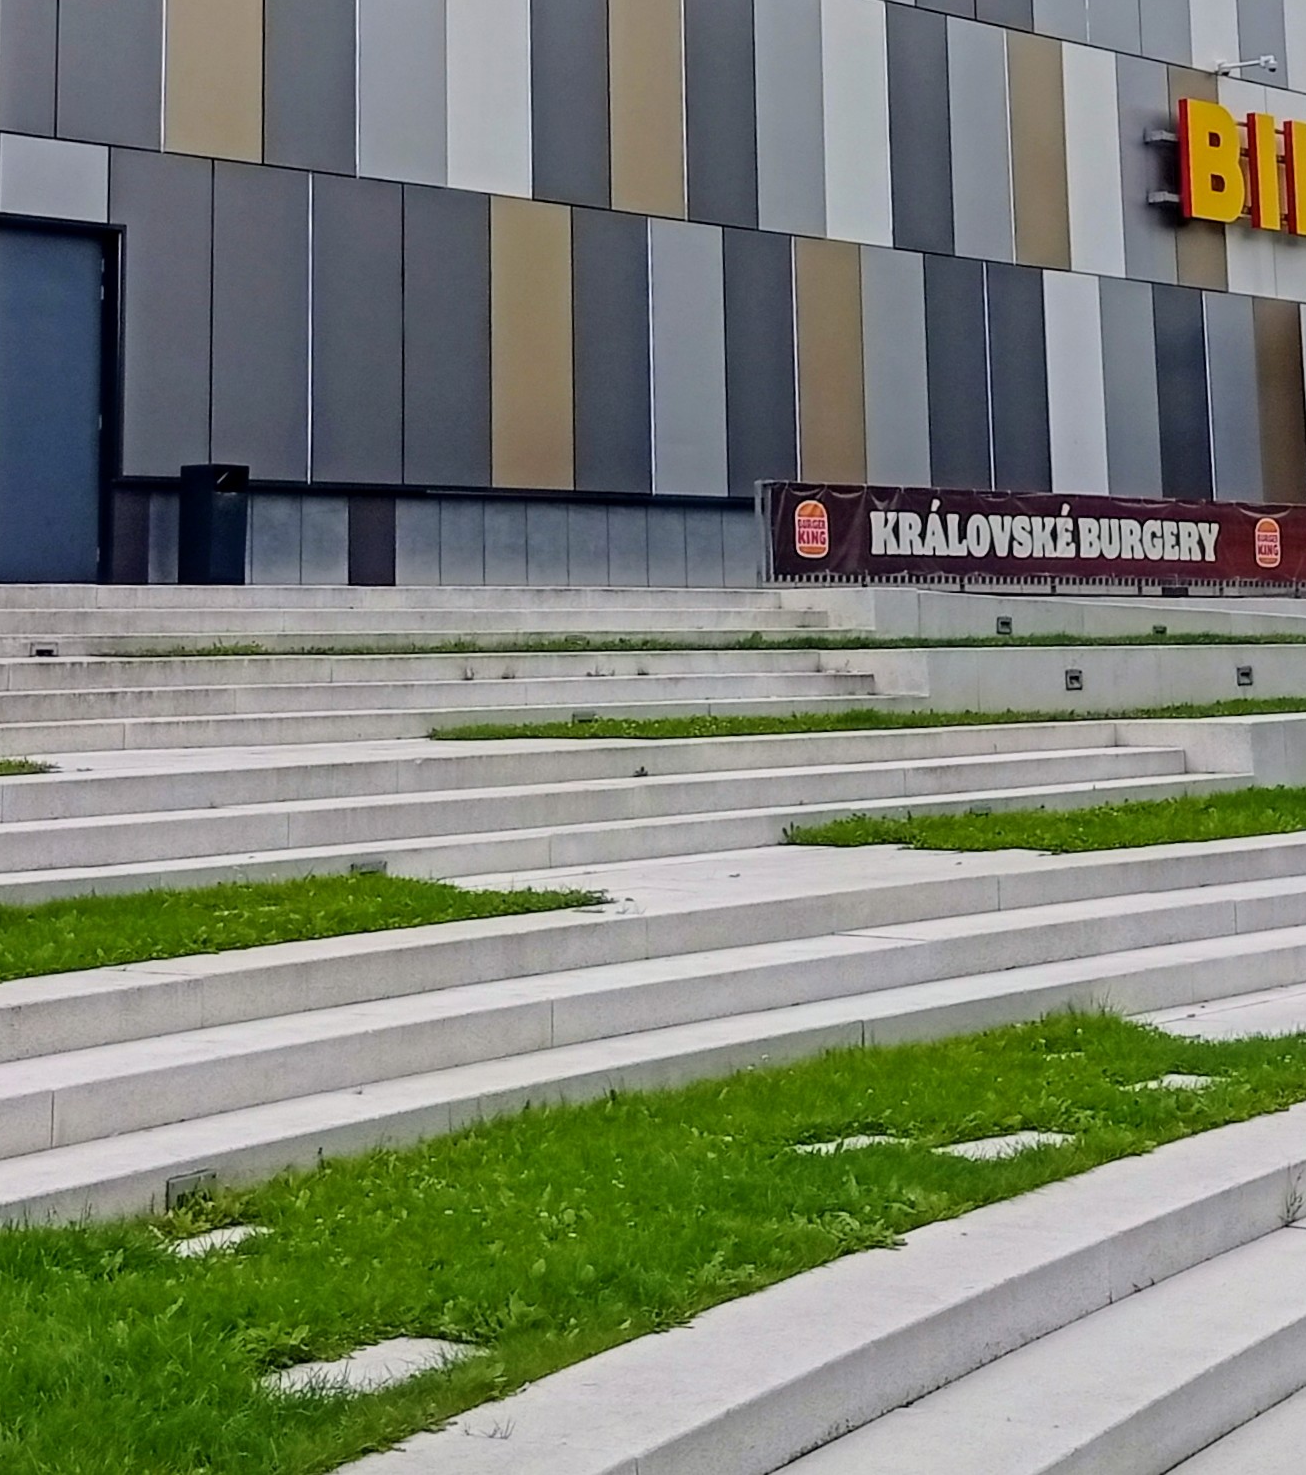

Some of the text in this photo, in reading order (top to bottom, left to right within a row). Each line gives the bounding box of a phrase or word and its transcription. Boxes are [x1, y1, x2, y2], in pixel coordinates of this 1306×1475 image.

[797, 518, 826, 530] BURGER
[870, 499, 1220, 562] KRÁLOVSKÉ BURGERY
[798, 529, 827, 546] KING
